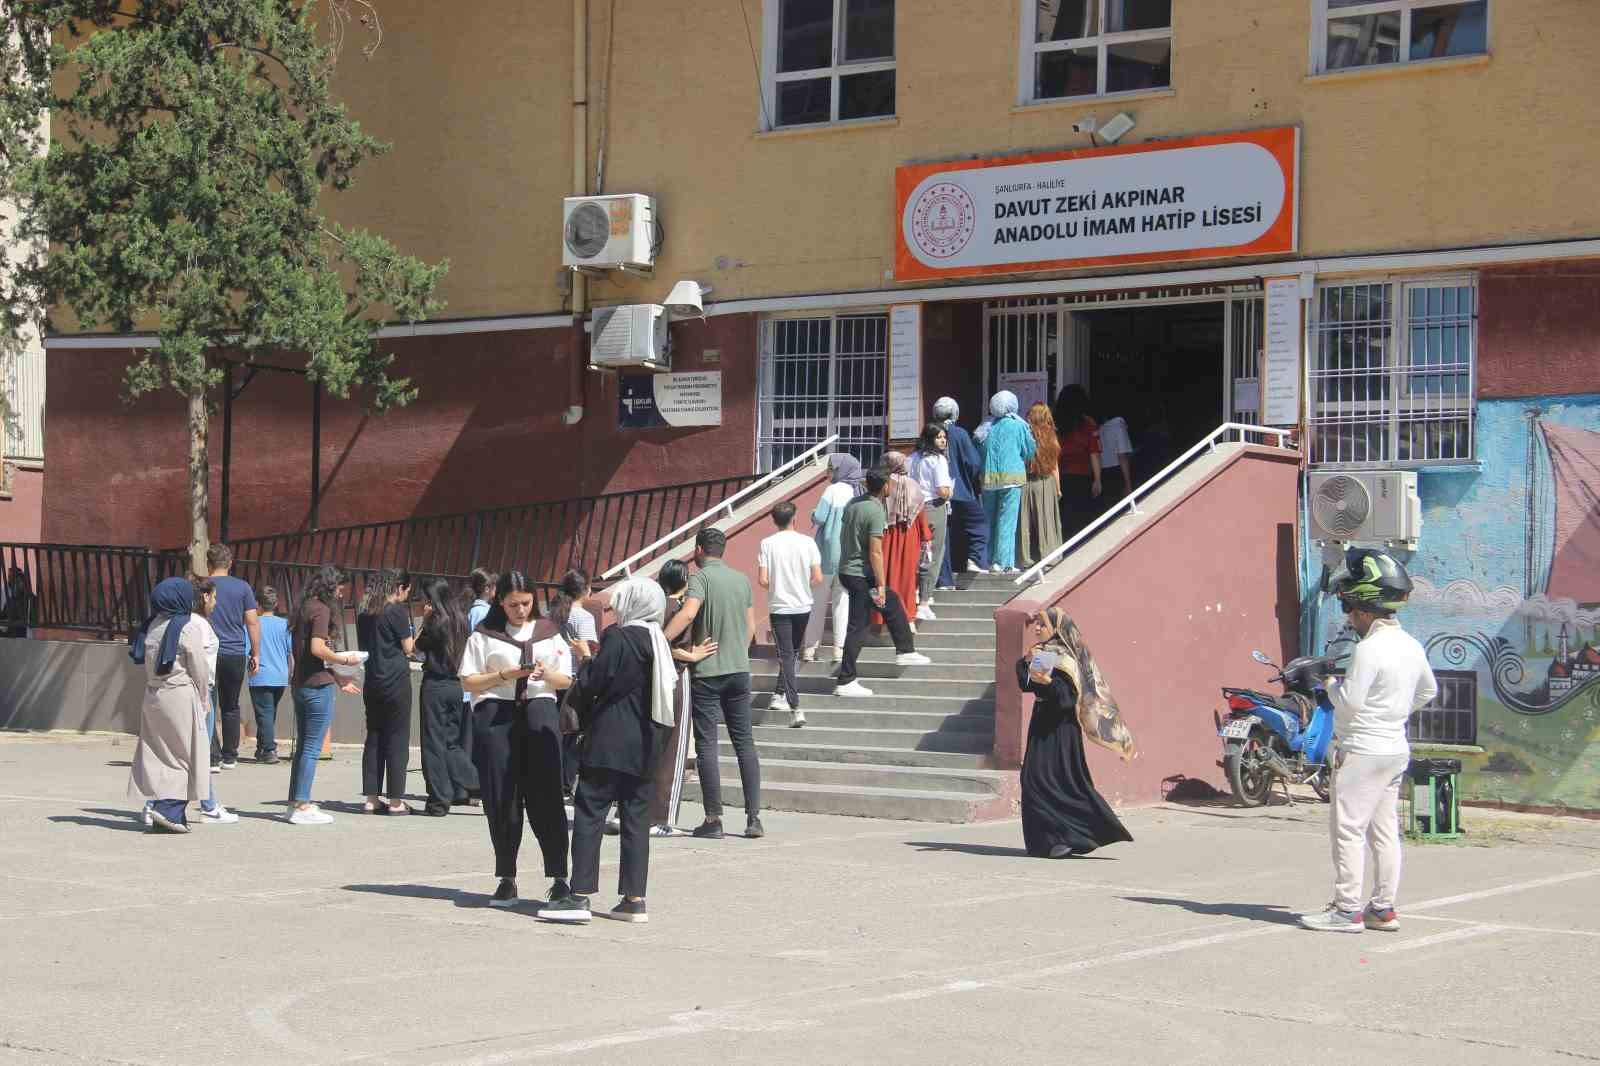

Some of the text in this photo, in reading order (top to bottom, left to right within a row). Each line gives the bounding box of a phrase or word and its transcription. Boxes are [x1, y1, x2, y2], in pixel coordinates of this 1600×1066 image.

[994, 186, 1185, 220] DAVUT ZEKİ AKPINAR
[993, 221, 1078, 245] ANADOLU
[1083, 216, 1136, 237] İMAM
[1141, 208, 1197, 233] HATİP
[1202, 201, 1262, 228] LİSESİ
